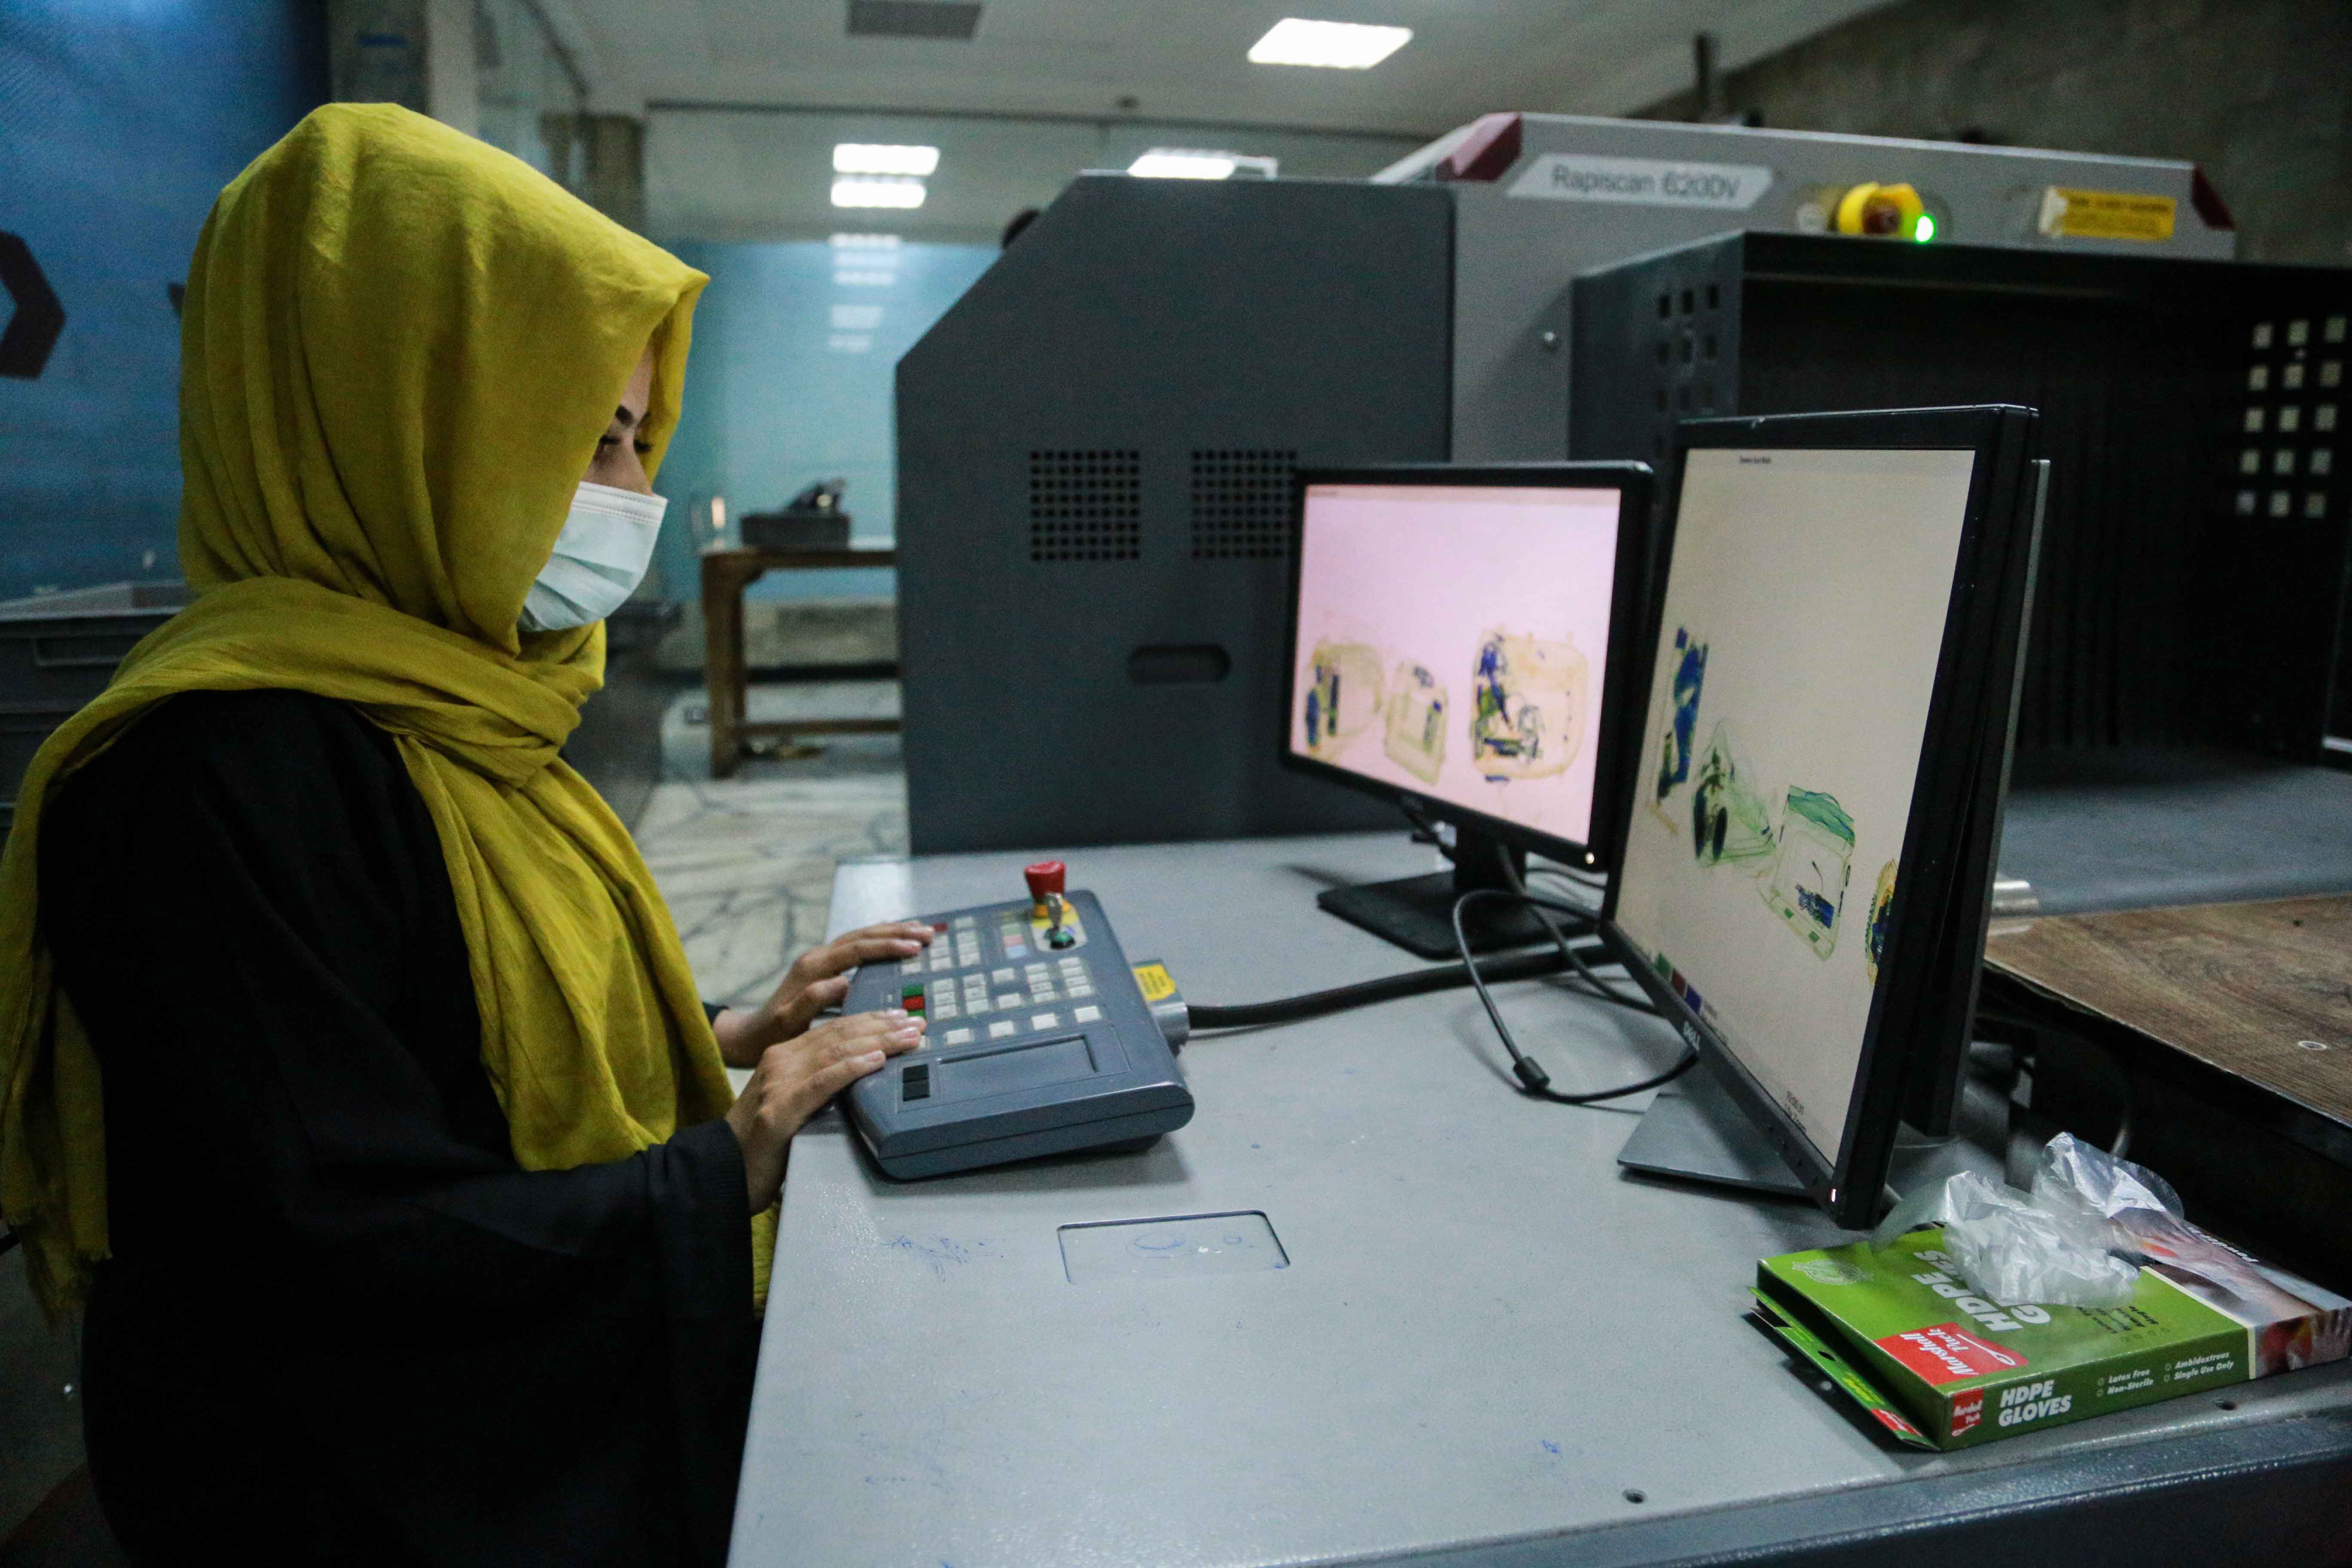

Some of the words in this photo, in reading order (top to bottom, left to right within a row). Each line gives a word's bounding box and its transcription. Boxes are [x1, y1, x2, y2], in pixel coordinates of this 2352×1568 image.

[1552, 163, 1655, 193] Rapiscan
[1911, 1272, 2023, 1331] HDPE
[1927, 1328, 1969, 1352] Pack
[1900, 1333, 1980, 1375] Marshall
[2174, 1352, 2230, 1369] Ambidextrous
[2108, 1373, 2131, 1384] Latex
[2132, 1369, 2150, 1378] Free
[2174, 1368, 2199, 1381] Single
[2200, 1365, 2214, 1375] Use
[2215, 1360, 2234, 1371] Only
[2000, 1379, 2055, 1408] HDPE
[2107, 1378, 2154, 1395] Non-Sterile
[1999, 1394, 2072, 1427] GLOVES
